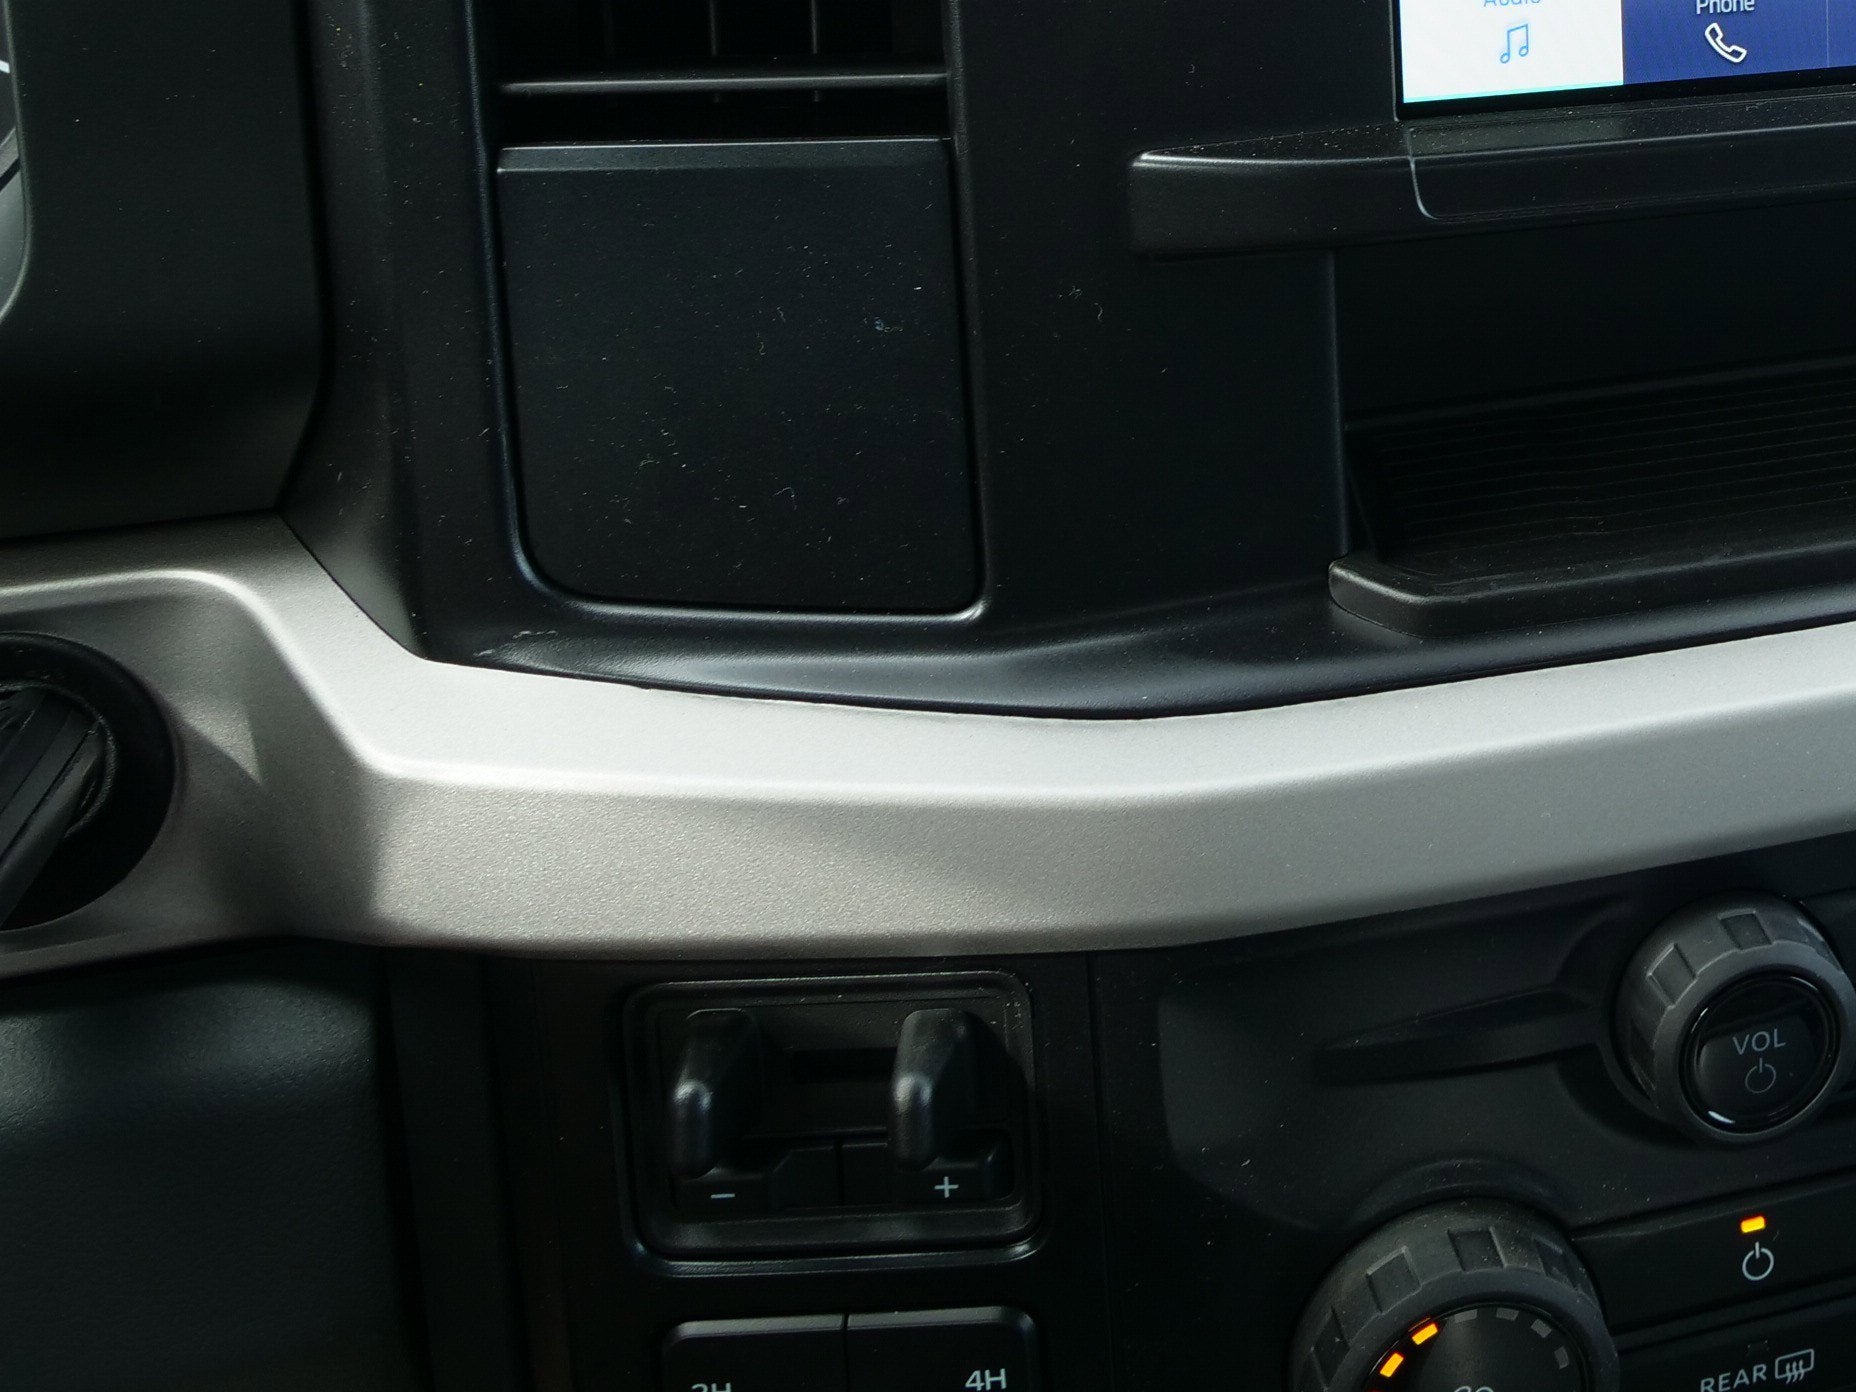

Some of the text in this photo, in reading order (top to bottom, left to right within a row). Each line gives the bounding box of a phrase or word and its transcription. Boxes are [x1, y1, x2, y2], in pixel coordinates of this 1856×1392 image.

[1732, 1029, 1786, 1056] VOL
[964, 1368, 1008, 1392] 4H
[1700, 1363, 1767, 1392] REAR
